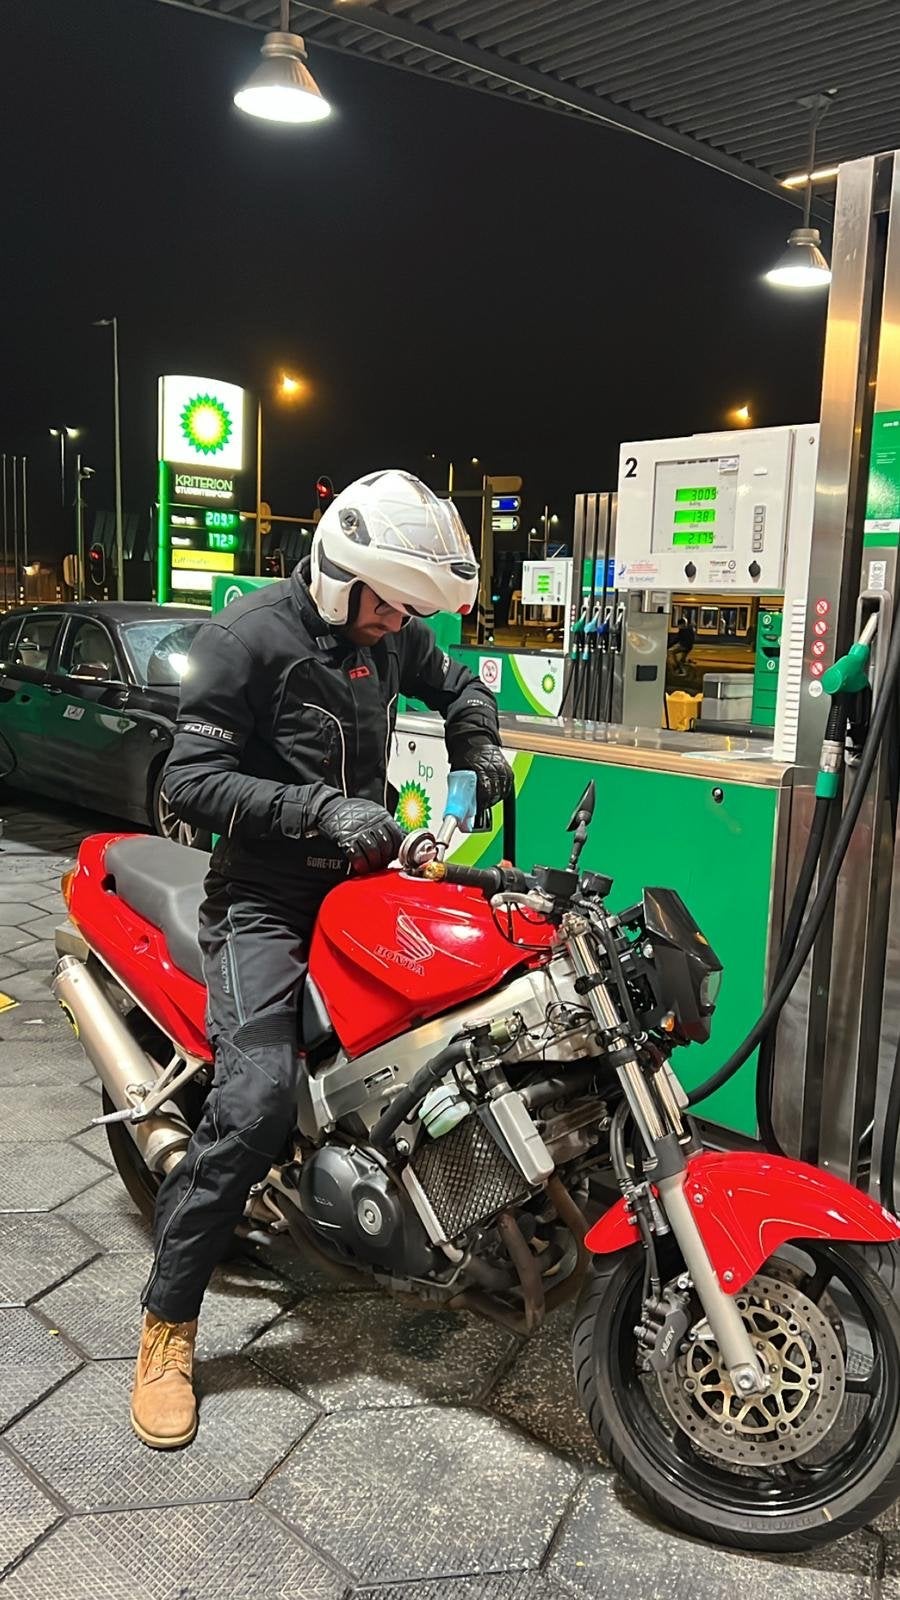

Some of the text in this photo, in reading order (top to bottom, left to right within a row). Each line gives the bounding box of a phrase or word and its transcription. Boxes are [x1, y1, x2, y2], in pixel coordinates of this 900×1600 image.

[624, 457, 638, 479] 2
[175, 474, 233, 491] KRITERION
[418, 760, 434, 782] bp
[306, 856, 342, 869] GORE-TEX
[373, 944, 425, 976] HONDA
